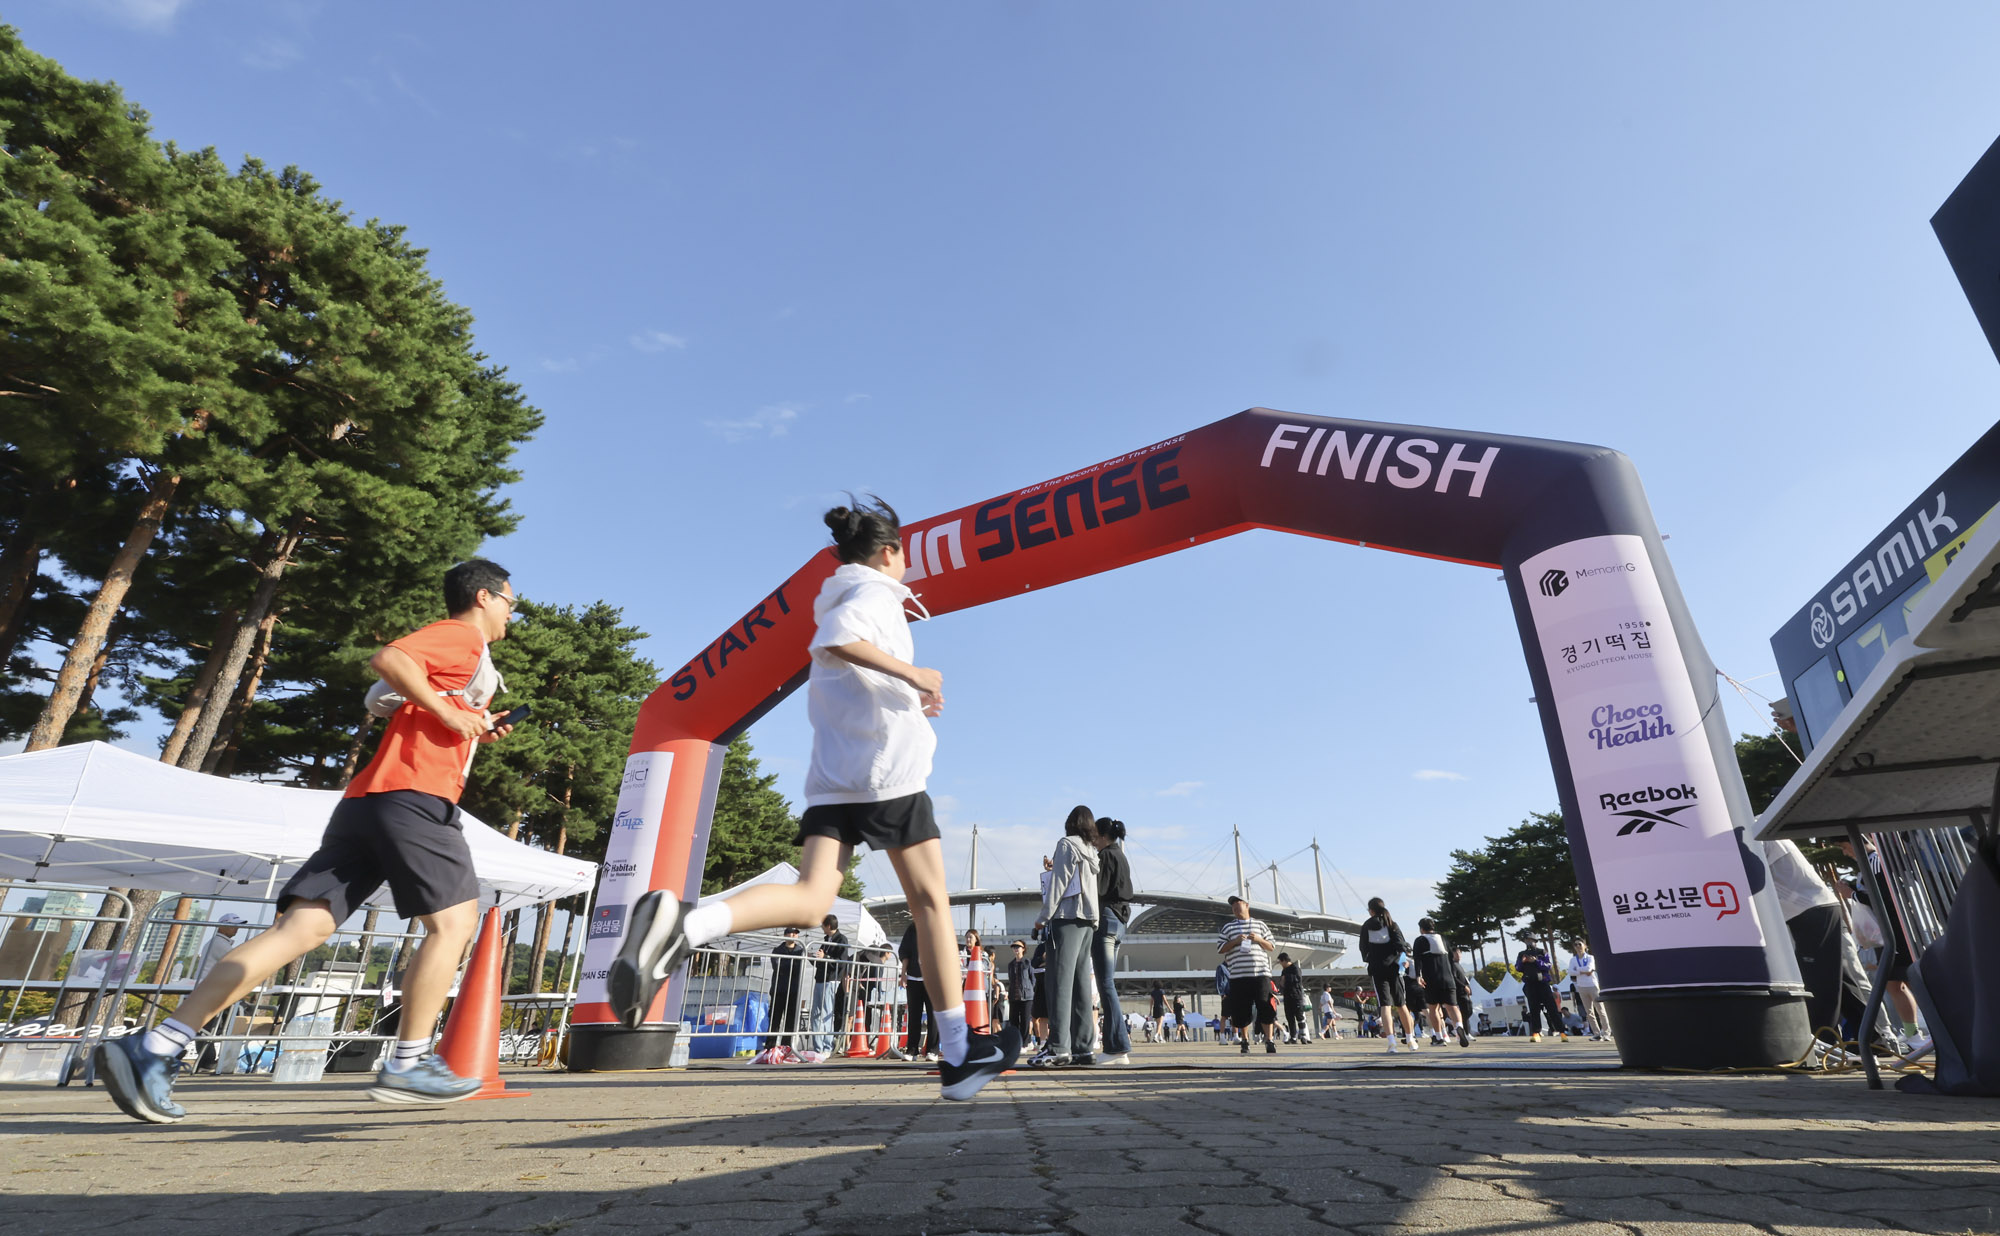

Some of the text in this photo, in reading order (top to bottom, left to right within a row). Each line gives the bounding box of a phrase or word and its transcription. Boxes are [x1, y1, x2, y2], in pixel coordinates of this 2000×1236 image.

[1020, 484, 1042, 496] RUN
[1044, 478, 1062, 488] The
[1103, 457, 1125, 468] Feel
[1128, 450, 1147, 460] The
[1150, 435, 1187, 452] SENSE
[1260, 423, 1500, 498] FINISH
[900, 446, 1191, 585] UN SENSE
[1576, 562, 1636, 579] MemorinG
[1830, 491, 1958, 626] SAMIK
[671, 580, 791, 702] START
[1619, 621, 1645, 630] 1958
[1561, 631, 1651, 664] 경기떡집
[1600, 655, 1626, 665] TTEOK
[1628, 652, 1654, 661] HOUSE
[1591, 703, 1663, 728] Choco
[1588, 715, 1676, 750] Health
[1599, 784, 1698, 811] Reebok
[1613, 887, 1702, 915] 일요신문
